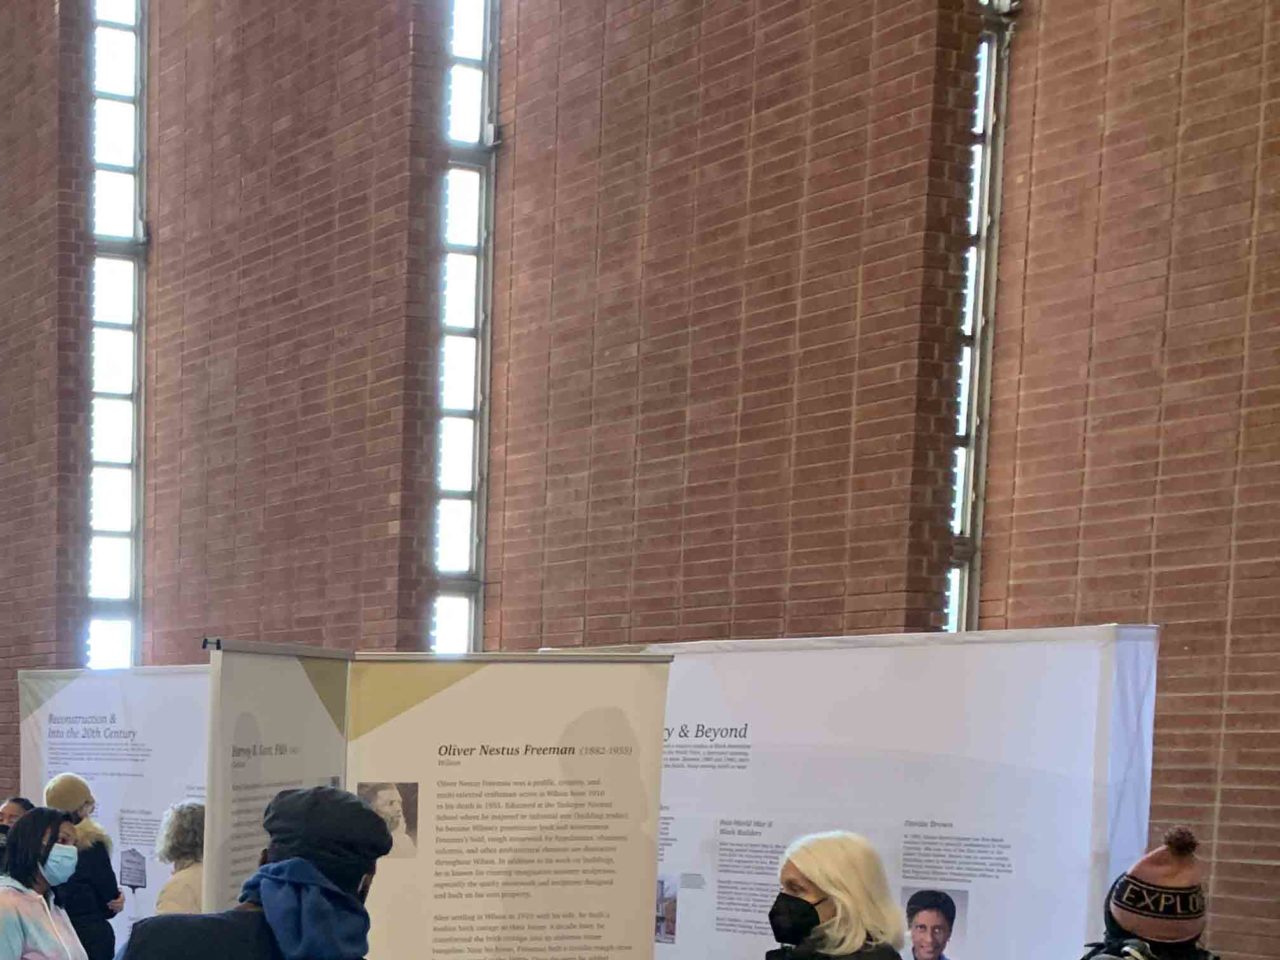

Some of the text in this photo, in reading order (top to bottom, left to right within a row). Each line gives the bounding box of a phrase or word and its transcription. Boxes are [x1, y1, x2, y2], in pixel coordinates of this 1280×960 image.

[48, 728, 136, 742] Into the 20th Century
[678, 724, 689, 738] &
[694, 723, 748, 742] Beyond
[438, 744, 476, 757] Oliver
[479, 744, 520, 756] Nestus
[524, 744, 576, 756] Freeman
[1122, 884, 1204, 913] EXPLO
